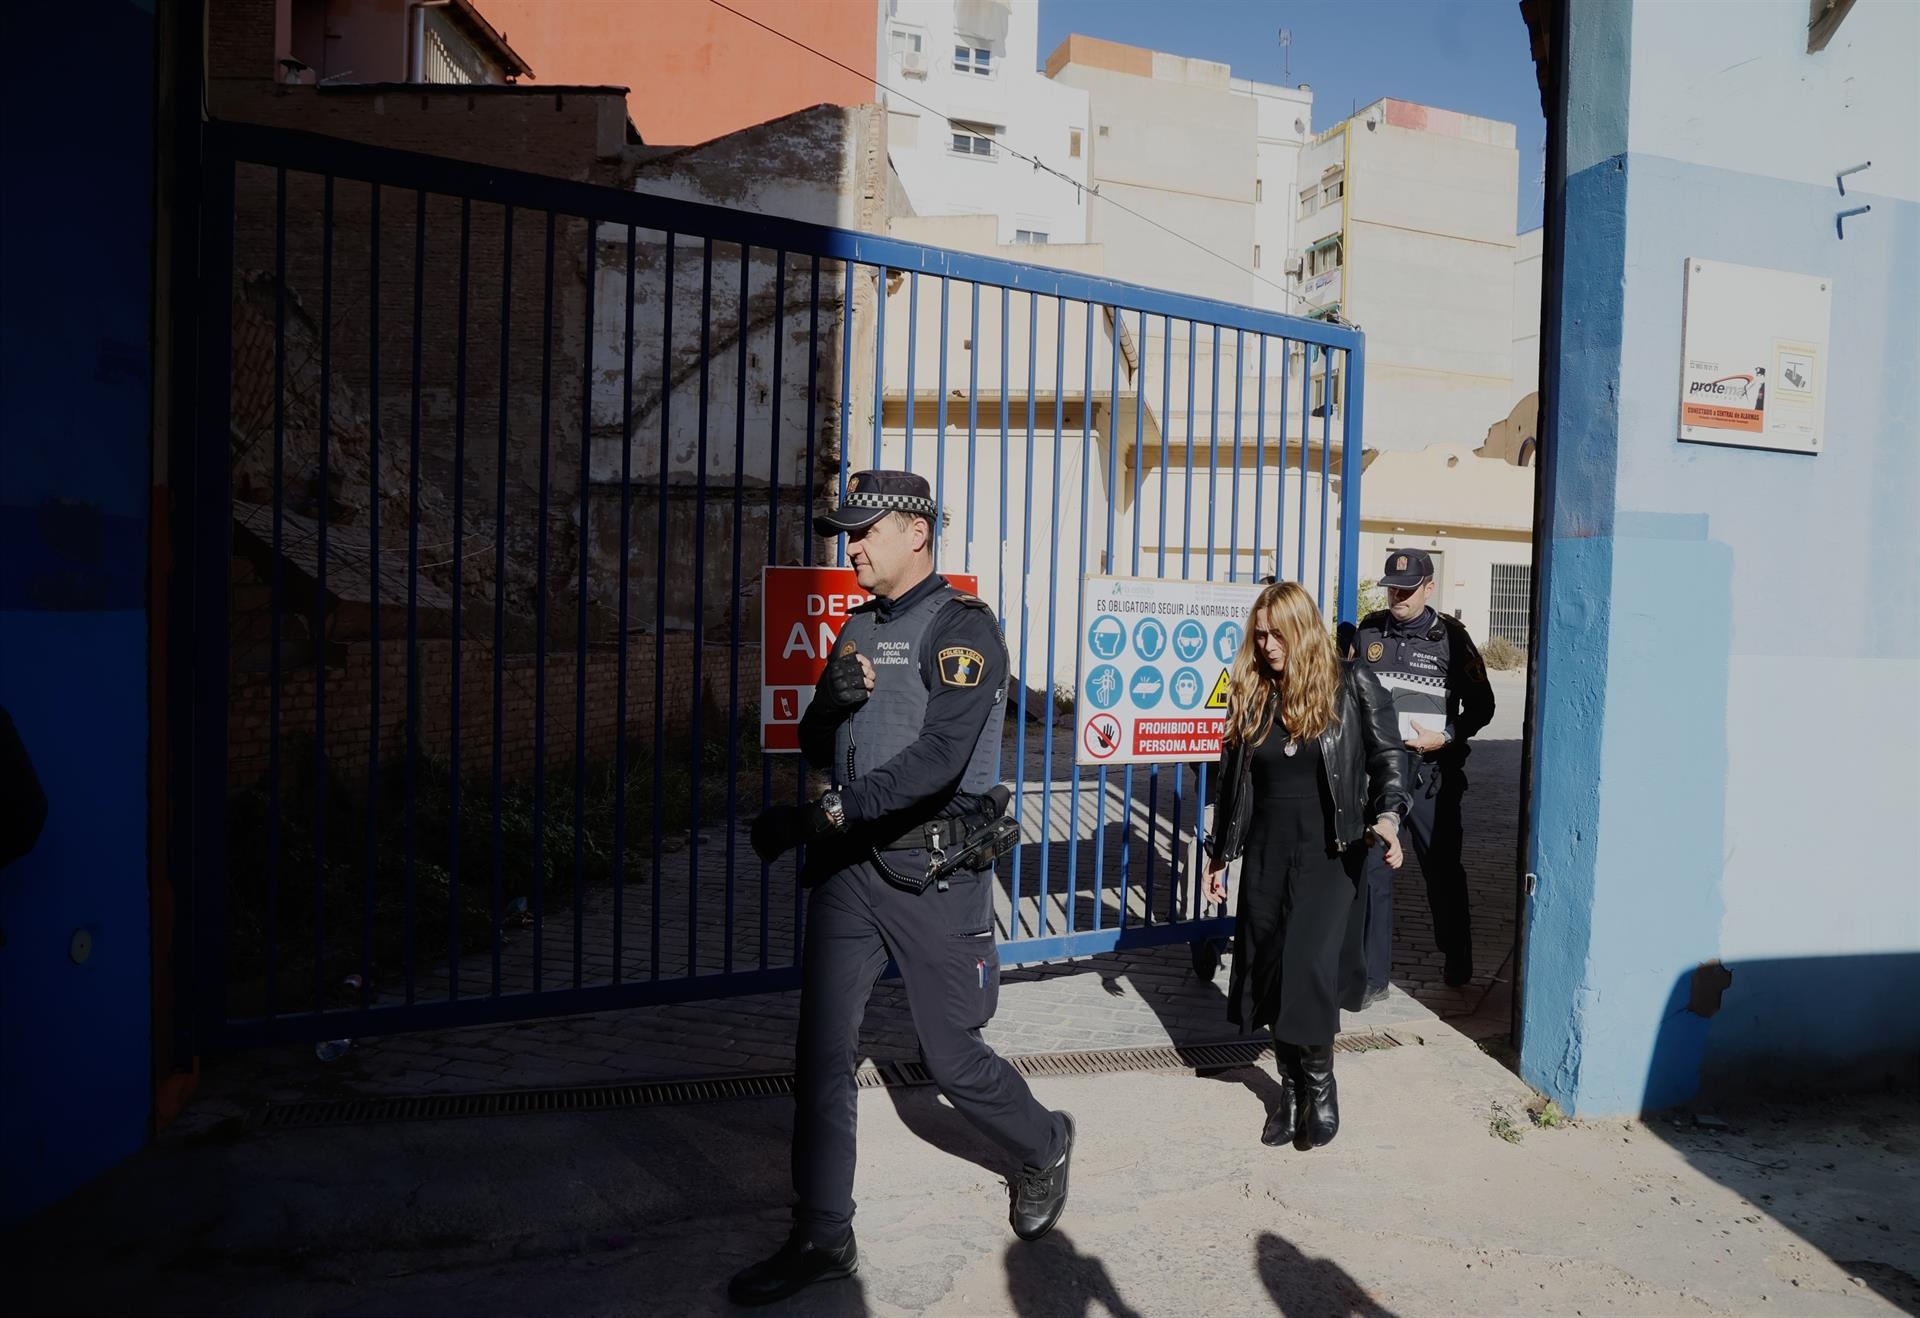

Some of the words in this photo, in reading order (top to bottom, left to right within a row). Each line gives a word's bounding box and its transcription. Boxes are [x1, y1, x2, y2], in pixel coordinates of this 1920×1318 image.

[1716, 410, 1734, 419] CENTRAL
[1740, 412, 1759, 420] ALARMAS
[1097, 600, 1106, 612] ES
[1108, 600, 1157, 614] OBLIGATORIO
[1157, 602, 1184, 615] SEGUIR
[1186, 604, 1199, 616] LAS
[1201, 605, 1230, 617] NORMAS
[1231, 607, 1239, 617] DE
[1139, 722, 1195, 734] PROHIBIDO
[1197, 722, 1209, 734] EL
[1139, 739, 1187, 752] PERSONA
[1188, 739, 1220, 751] AJENA
